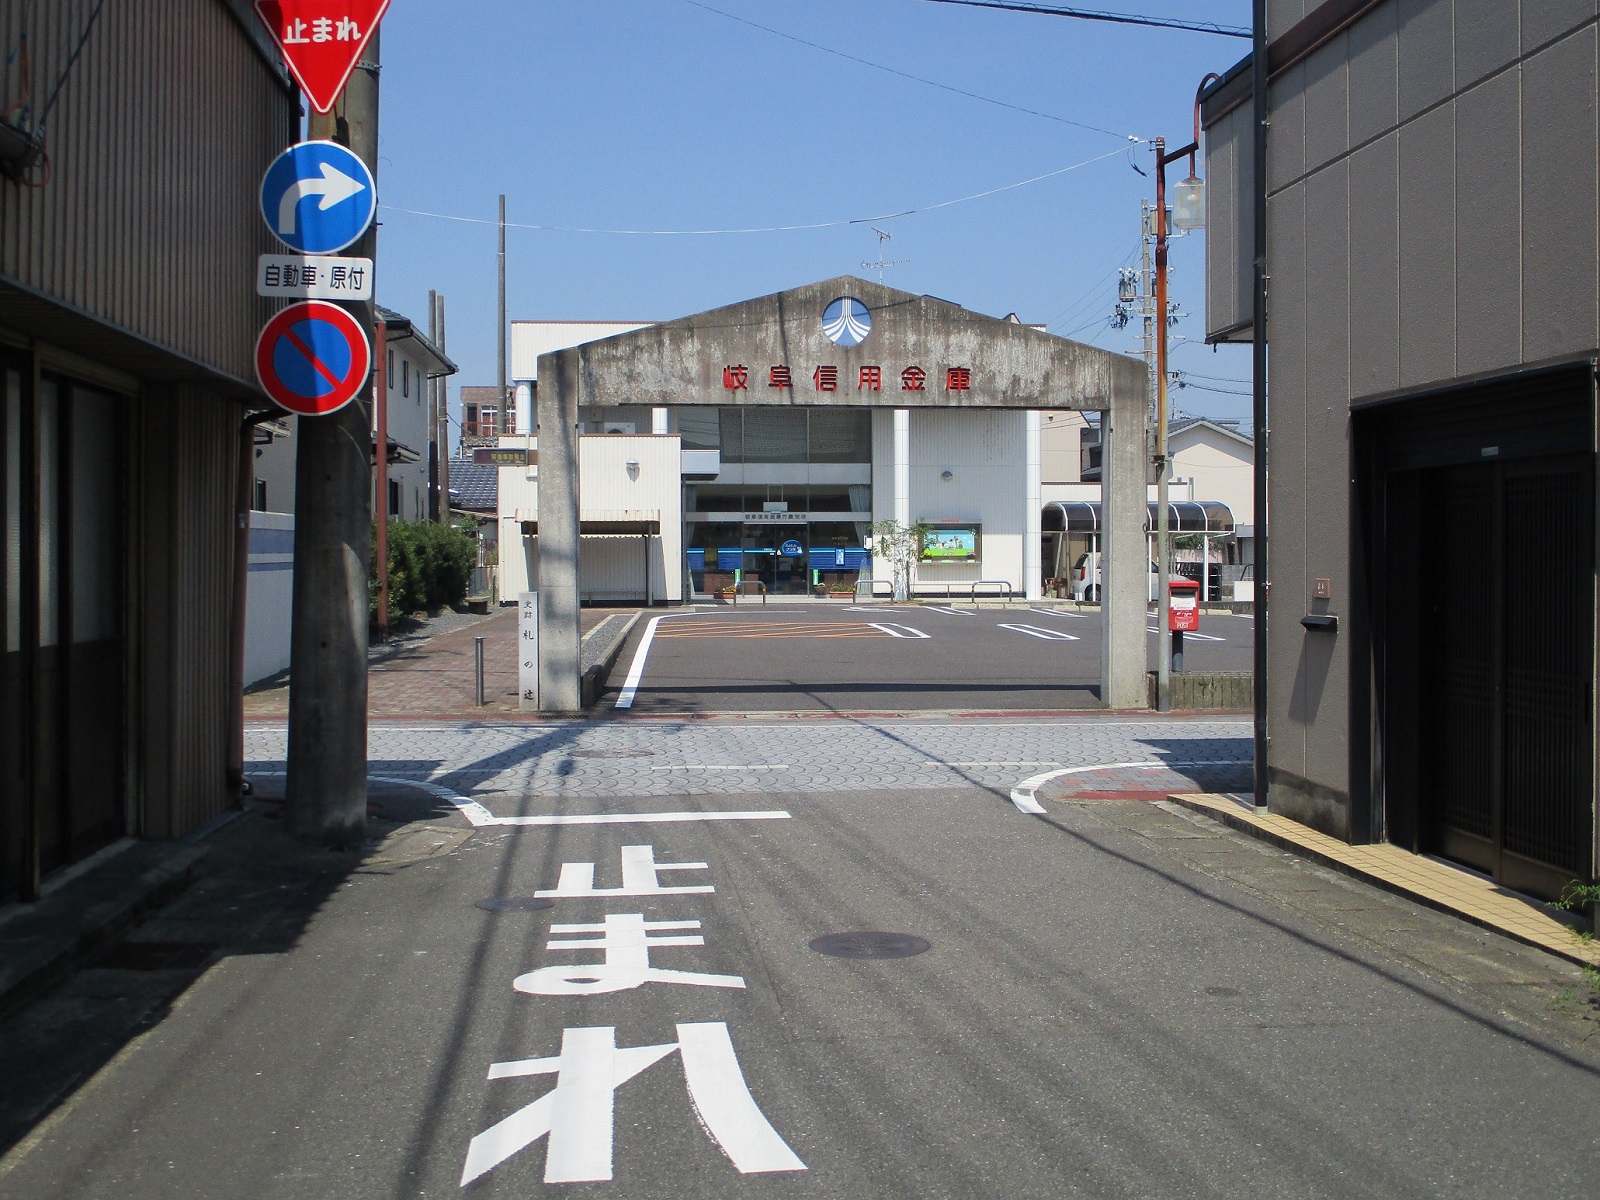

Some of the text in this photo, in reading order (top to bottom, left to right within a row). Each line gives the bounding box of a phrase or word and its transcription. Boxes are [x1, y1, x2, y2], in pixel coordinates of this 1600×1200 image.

[283, 15, 362, 44] 止まれ
[264, 263, 365, 291] 自動車・原付
[722, 364, 971, 393] 岐阜信用金庫
[460, 845, 808, 1186] 止まれ
